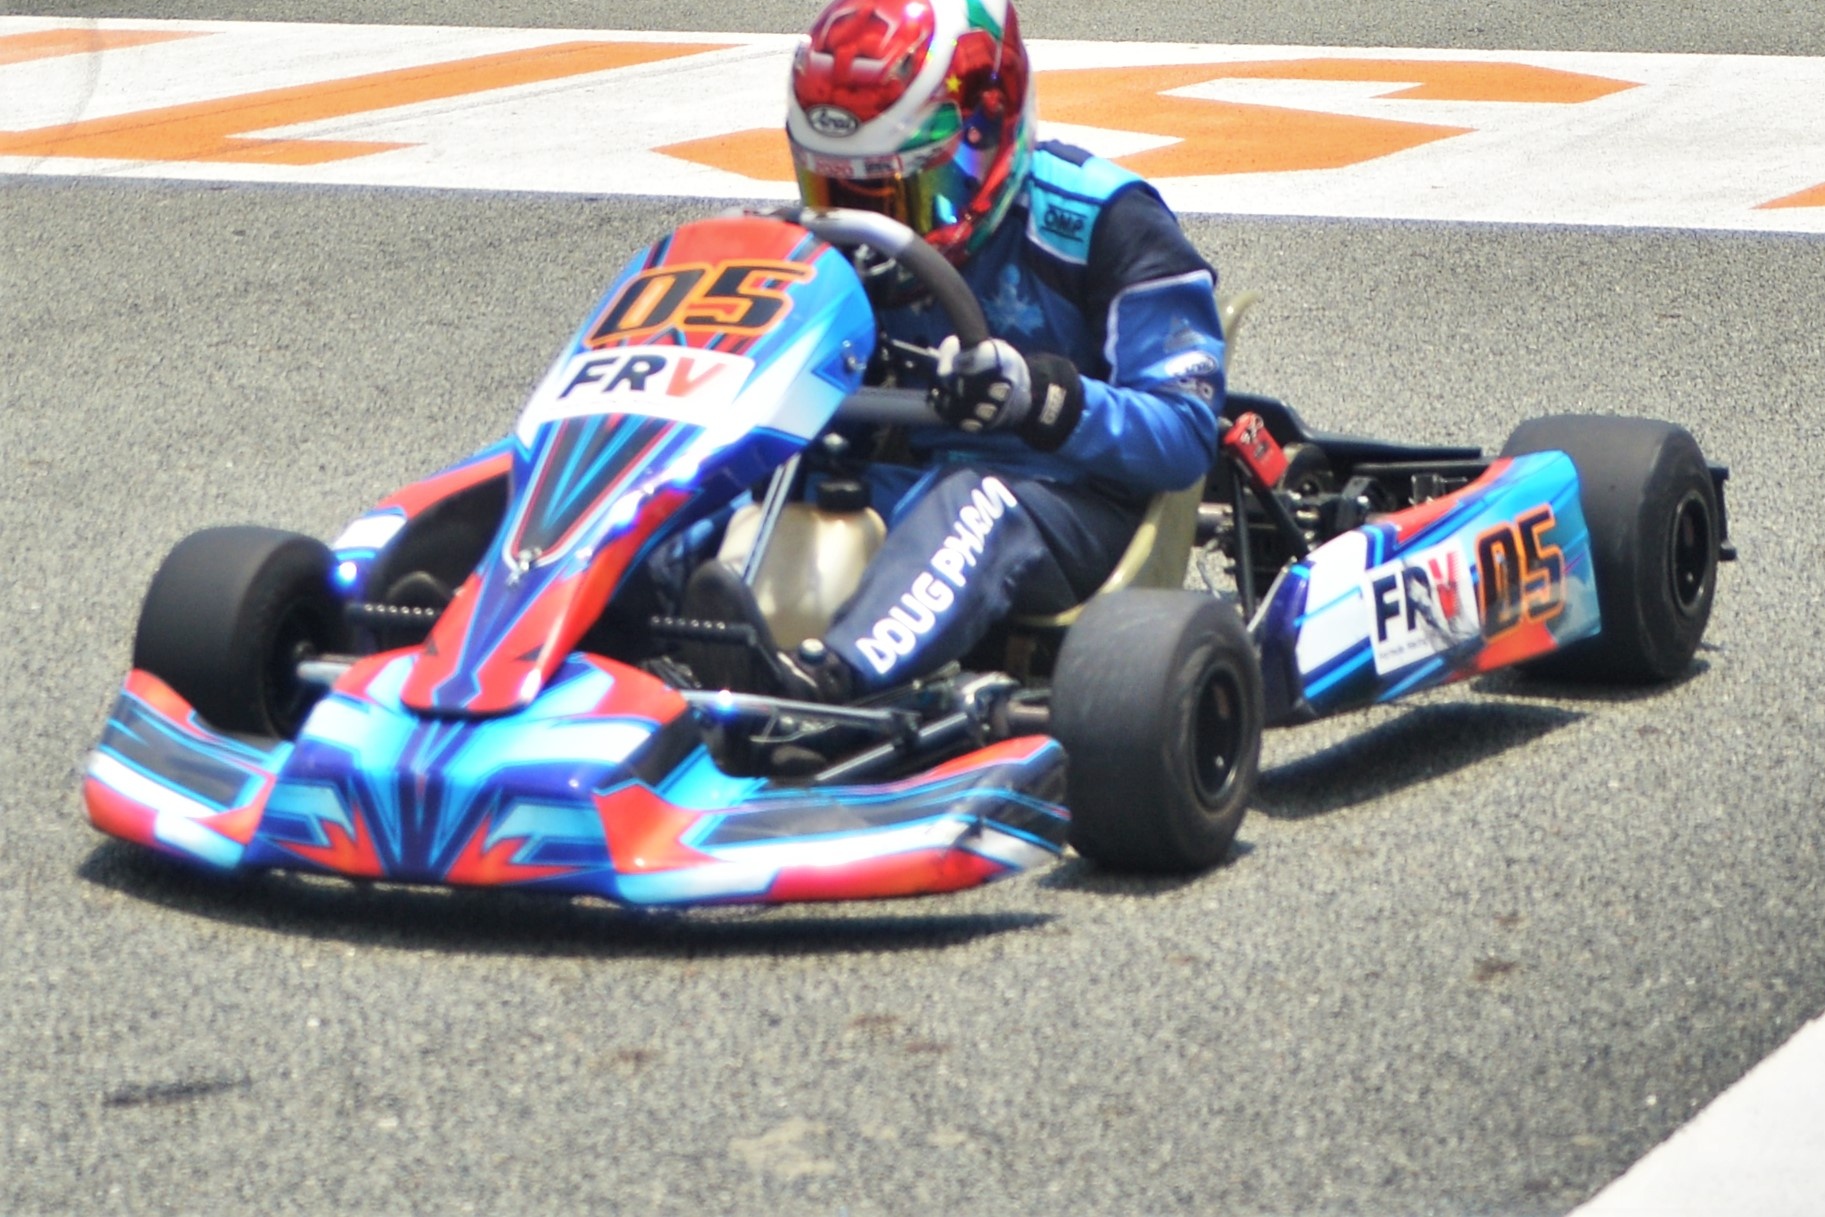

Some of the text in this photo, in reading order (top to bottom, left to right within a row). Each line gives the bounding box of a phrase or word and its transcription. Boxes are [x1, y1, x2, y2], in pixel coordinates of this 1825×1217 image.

[584, 258, 817, 349] 05
[557, 354, 727, 399] FRV
[1371, 501, 1567, 645] FRV 05
[856, 571, 955, 675] DOUG
